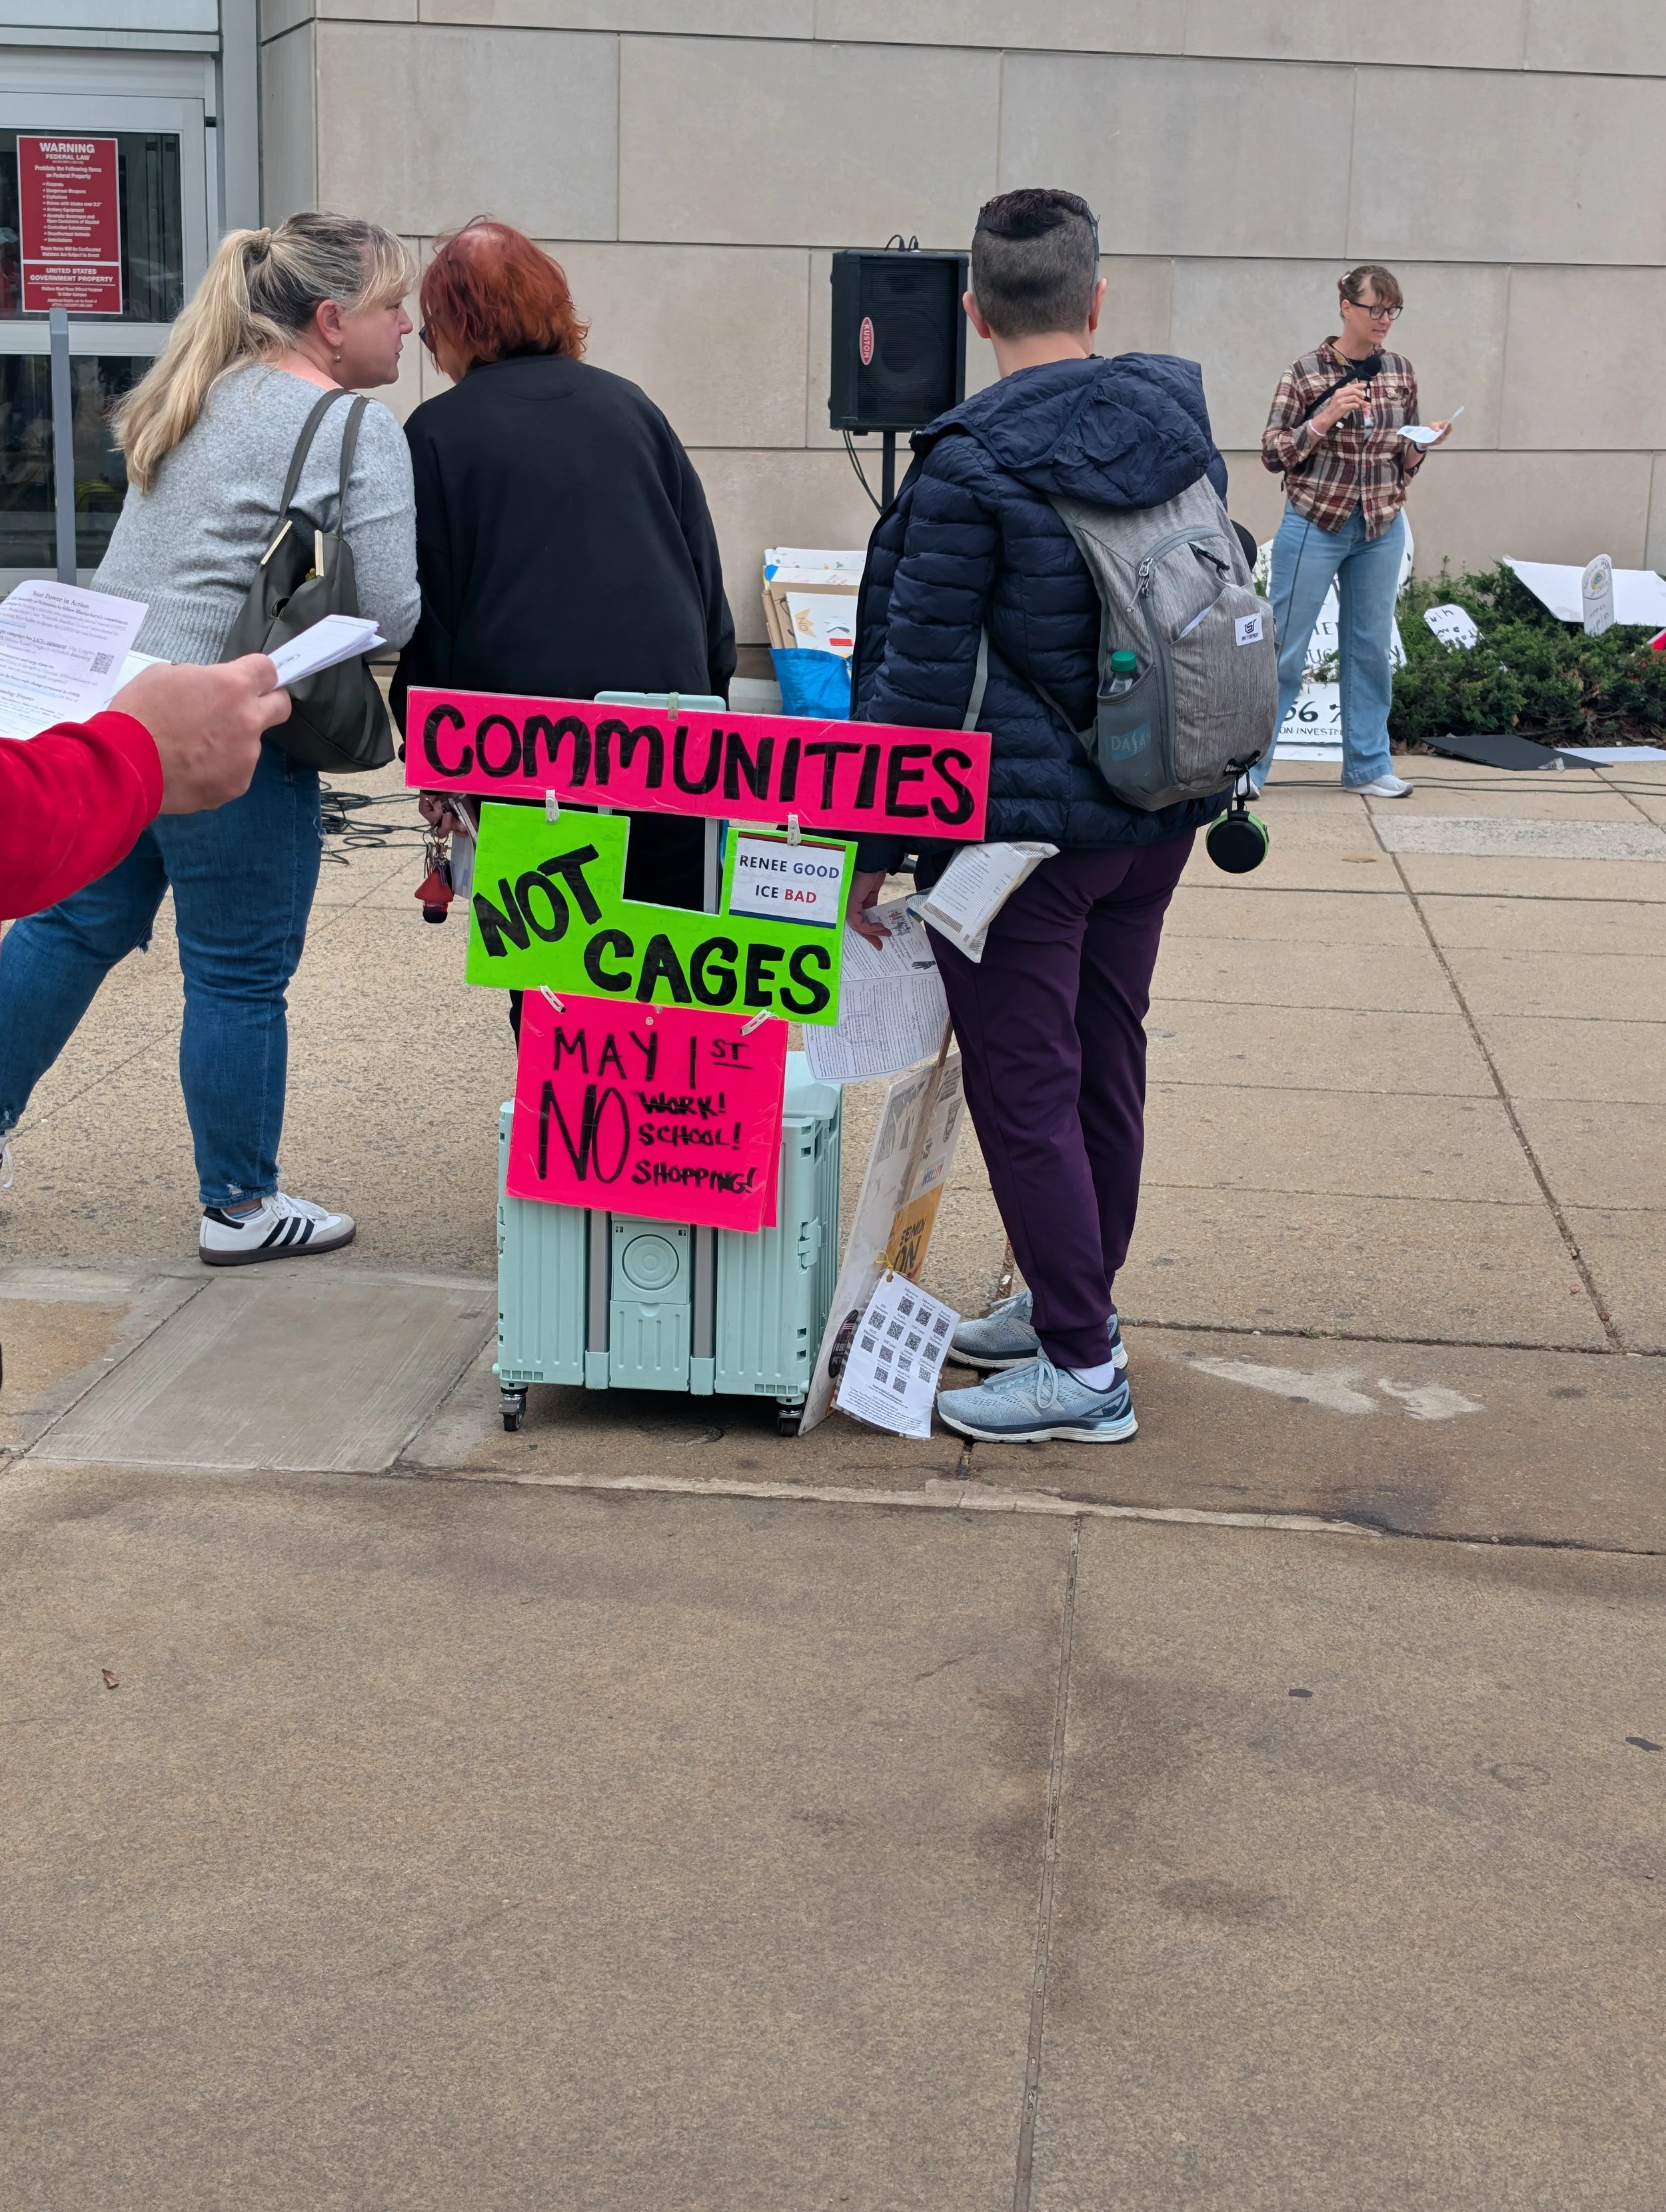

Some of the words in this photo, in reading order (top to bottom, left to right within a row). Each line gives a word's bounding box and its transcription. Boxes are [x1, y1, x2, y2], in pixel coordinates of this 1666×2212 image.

[39, 143, 95, 153] WARNING
[45, 593, 62, 602] Power
[70, 599, 90, 608] Action
[423, 704, 974, 826] COMMUNITIES
[739, 855, 788, 872] RENEE
[793, 863, 840, 879] GOOD
[473, 843, 602, 957] NOT
[755, 885, 778, 898] ICE
[784, 889, 816, 903] BAD
[583, 929, 832, 1014] CAGES
[553, 1026, 658, 1082] MAY
[637, 1091, 726, 1119] WORK!
[537, 1080, 631, 1184] NO
[637, 1122, 742, 1150] SCHOOL!
[631, 1159, 758, 1194] SHOPPING!
